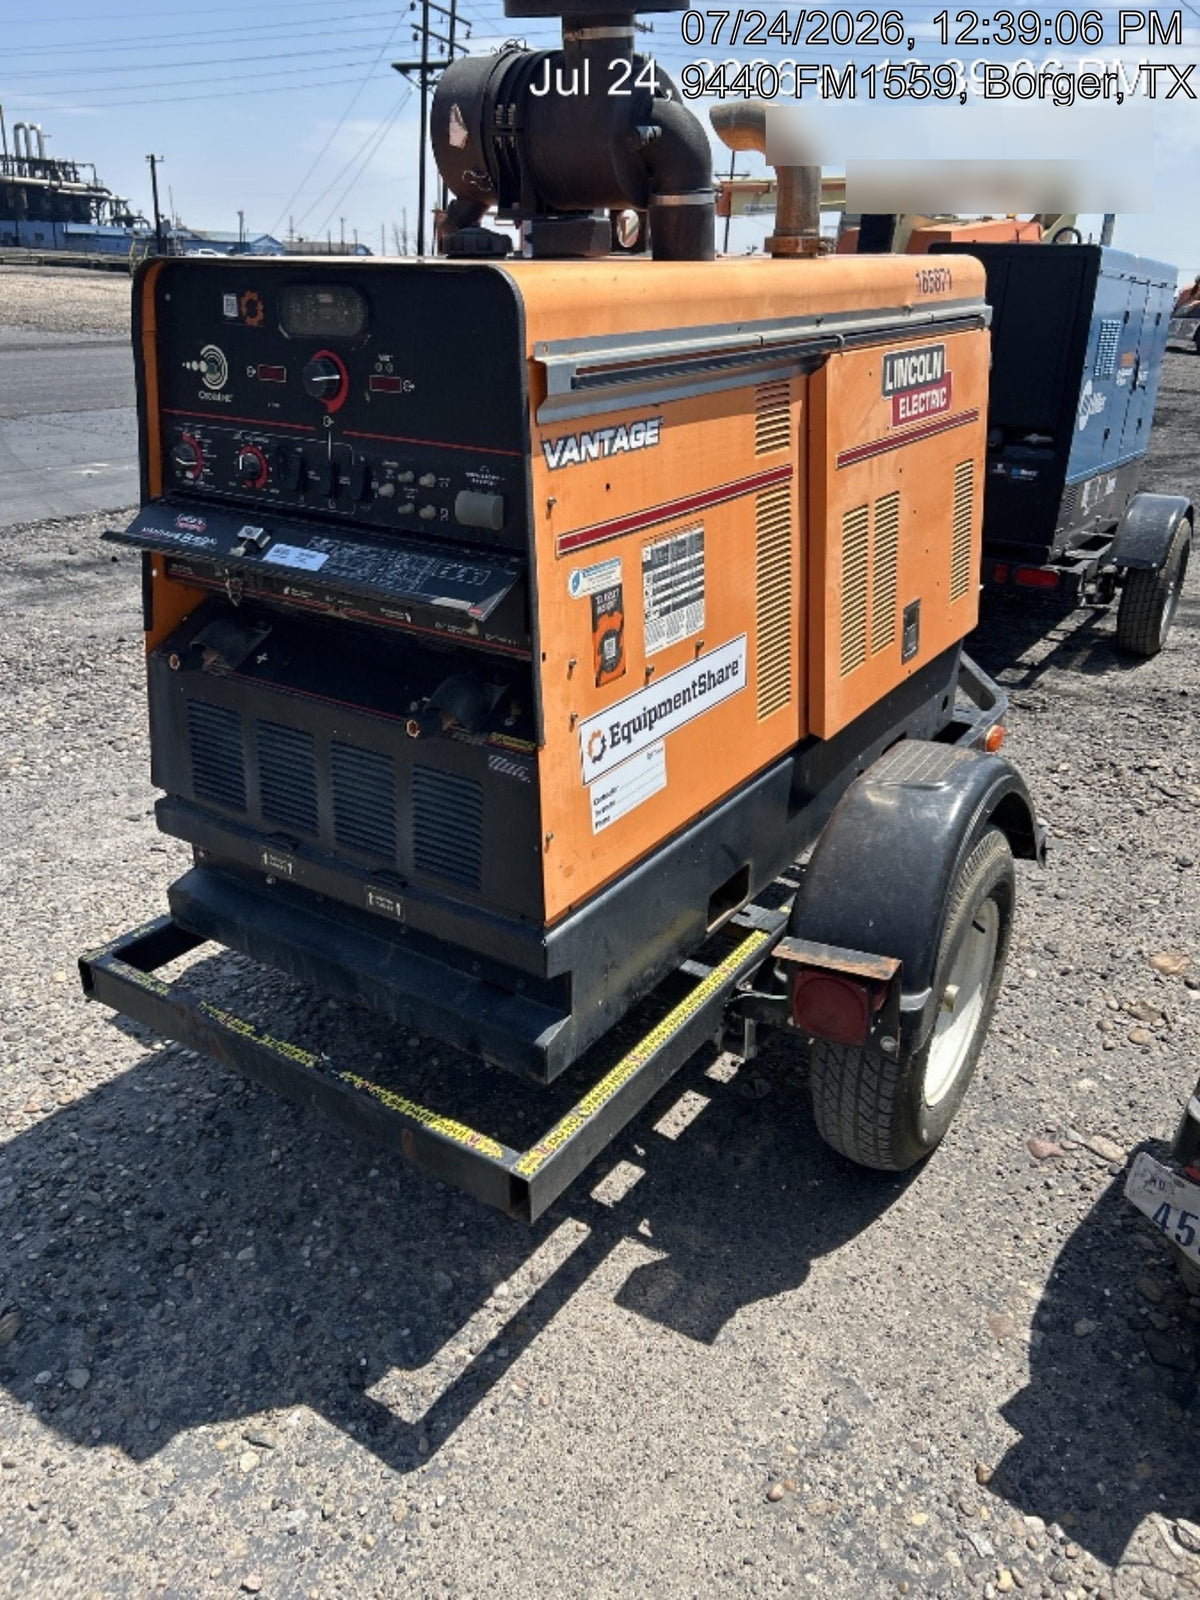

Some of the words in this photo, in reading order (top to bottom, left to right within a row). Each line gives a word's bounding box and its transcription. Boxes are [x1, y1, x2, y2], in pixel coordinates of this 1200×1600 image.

[915, 268, 953, 294] 165871
[884, 350, 943, 392] LINCOLN
[899, 386, 947, 420] ELECTRIC
[542, 417, 662, 470] VANTAGE
[608, 658, 740, 749] EquipmentShare
